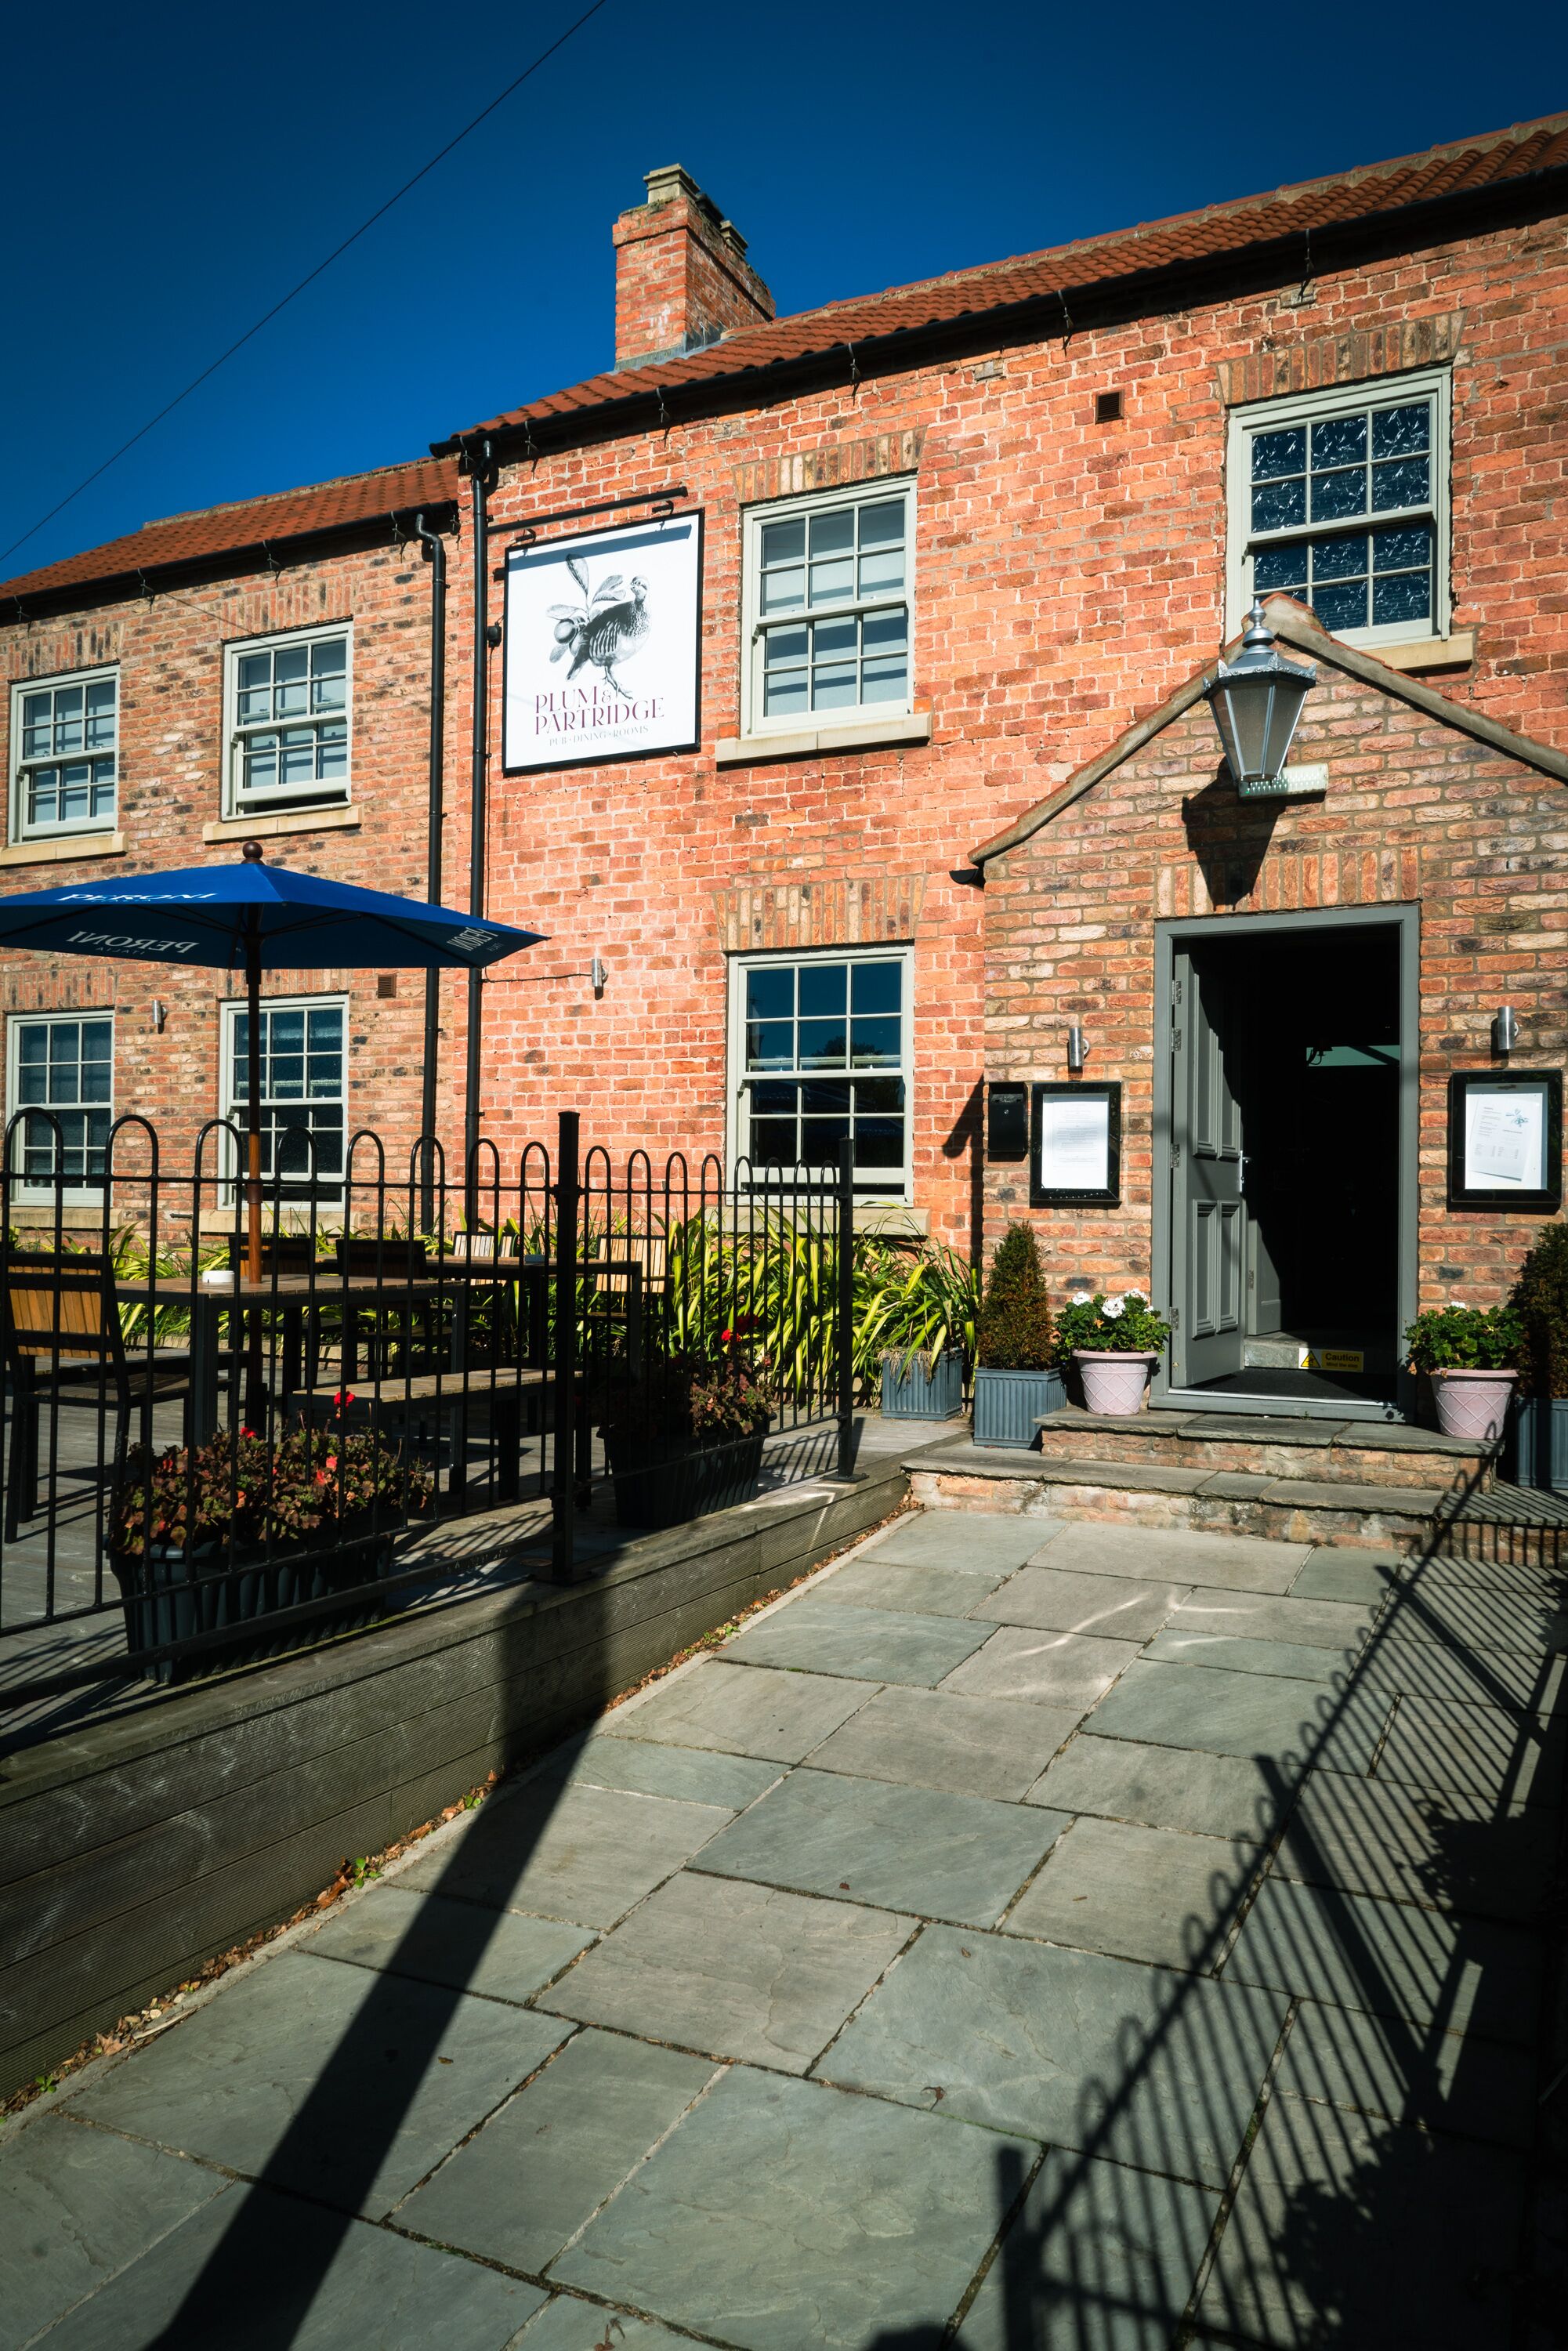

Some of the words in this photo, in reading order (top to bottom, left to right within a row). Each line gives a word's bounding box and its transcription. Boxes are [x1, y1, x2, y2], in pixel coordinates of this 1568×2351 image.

[536, 686, 597, 713] PLUM
[601, 690, 612, 704] &
[536, 697, 664, 735] PARTRIDGE
[549, 737, 567, 747] PUB
[574, 731, 607, 744] DINING
[613, 725, 649, 738] ROOMS
[1325, 1353, 1360, 1362] Caution
